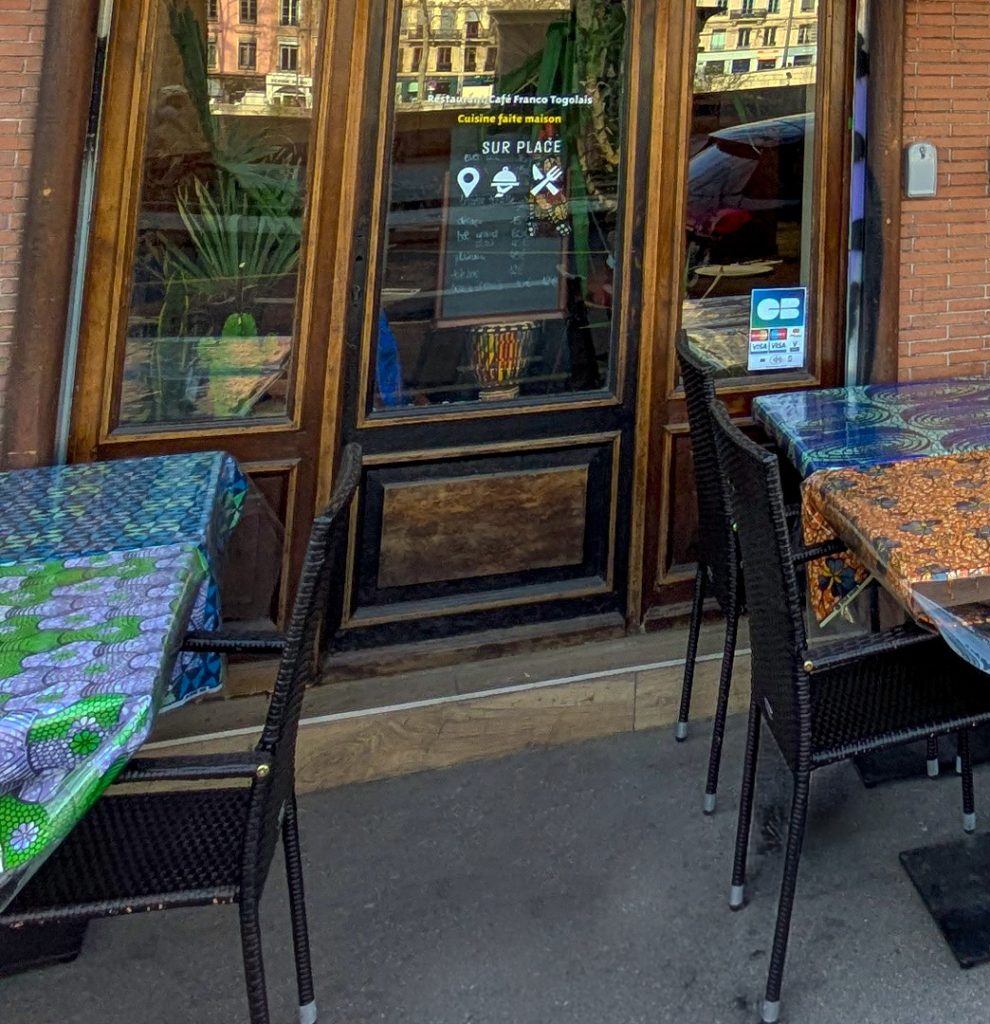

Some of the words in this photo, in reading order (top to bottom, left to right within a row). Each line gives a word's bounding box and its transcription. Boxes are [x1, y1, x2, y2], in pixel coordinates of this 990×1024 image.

[489, 93, 512, 106] Café
[513, 94, 548, 105] Franco
[551, 94, 593, 107] Togolais
[457, 113, 496, 124] Cuisine
[497, 112, 523, 125] faite
[524, 114, 562, 124] maison
[482, 140, 510, 155] SUR
[516, 138, 562, 154] PLACE
[756, 297, 800, 321] CB
